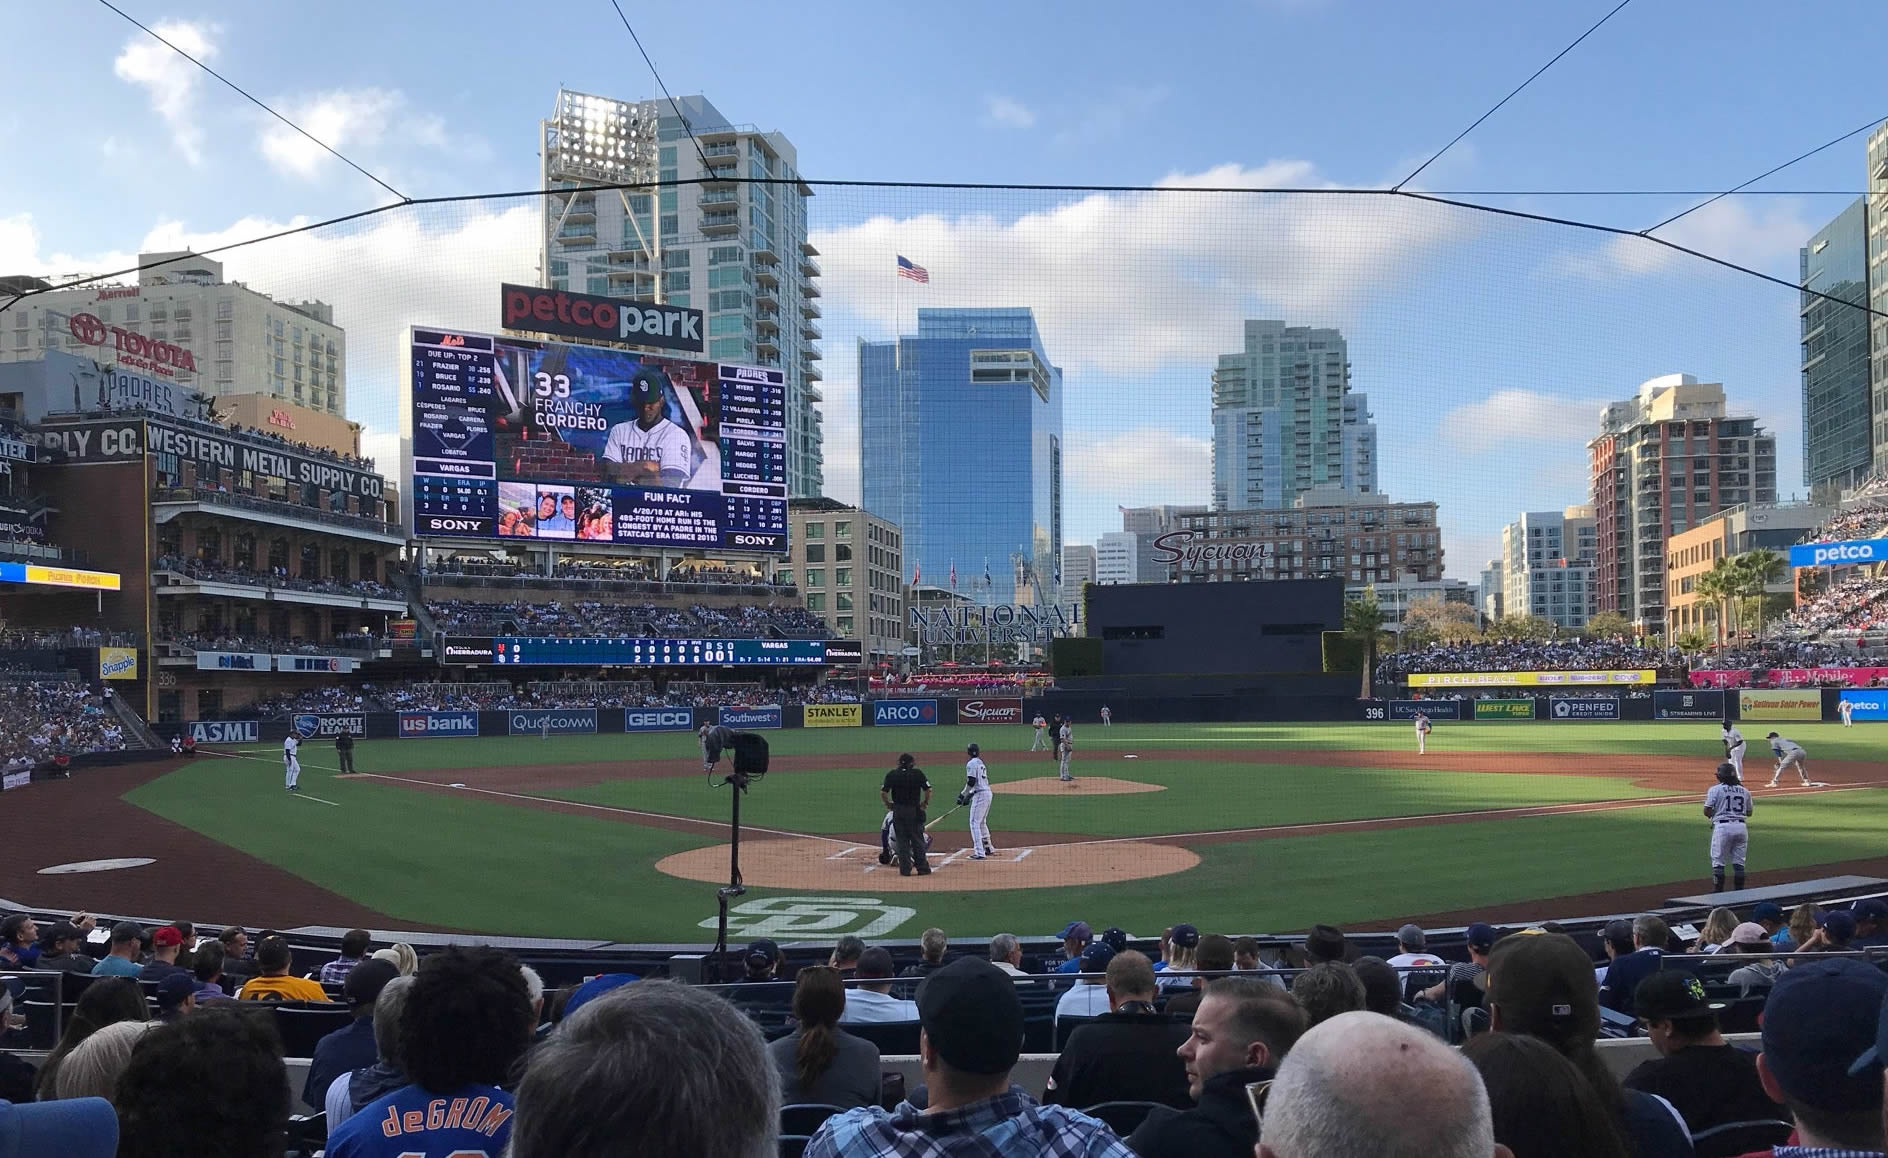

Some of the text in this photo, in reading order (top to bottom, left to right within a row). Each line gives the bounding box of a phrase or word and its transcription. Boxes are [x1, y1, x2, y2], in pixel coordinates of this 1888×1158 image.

[111, 326, 197, 373] TOYOTA
[432, 362, 460, 370] FRAZIER
[436, 372, 456, 380] BRUCE
[736, 368, 769, 383] PADRES
[432, 383, 460, 392] ROSARIO
[535, 372, 571, 398] 33
[106, 371, 175, 414] PADRES
[535, 398, 602, 417] FRANCHY
[730, 406, 760, 414] VILLANUEVA
[424, 412, 448, 420] ROSARIO
[535, 412, 608, 431] CORDERO
[101, 427, 143, 456] CO.
[147, 424, 384, 499] WESTERN METAL SUPPLY CO.
[440, 464, 470, 473] VARGAS
[644, 492, 692, 504] FUN FACT
[430, 518, 482, 530] SONY
[618, 522, 651, 531] LONGEST
[618, 530, 654, 538] STATCAST
[735, 535, 776, 546] SONY
[1152, 530, 1272, 572] Sycuan
[1814, 544, 1873, 564] petco
[908, 603, 1084, 628] NATIONAL
[923, 626, 1072, 645] UNIVERSITY
[513, 654, 520, 662] 2
[102, 656, 135, 676] Snapple
[158, 671, 177, 686] 336
[1478, 675, 1516, 683] BEACH
[961, 702, 1017, 721] Sycuan
[1477, 704, 1504, 712] WEST
[1752, 701, 1780, 709] Sullivan
[628, 712, 690, 726] GEICO
[723, 712, 771, 723] Southwest
[808, 708, 857, 718] STANLEY
[876, 706, 920, 720] ARCO
[1366, 708, 1384, 719] 396
[320, 717, 362, 726] ROCKET
[192, 722, 257, 742] ASML
[320, 726, 362, 734] LEAUE
[1725, 796, 1745, 812] 13
[381, 1096, 514, 1138] deGROM
